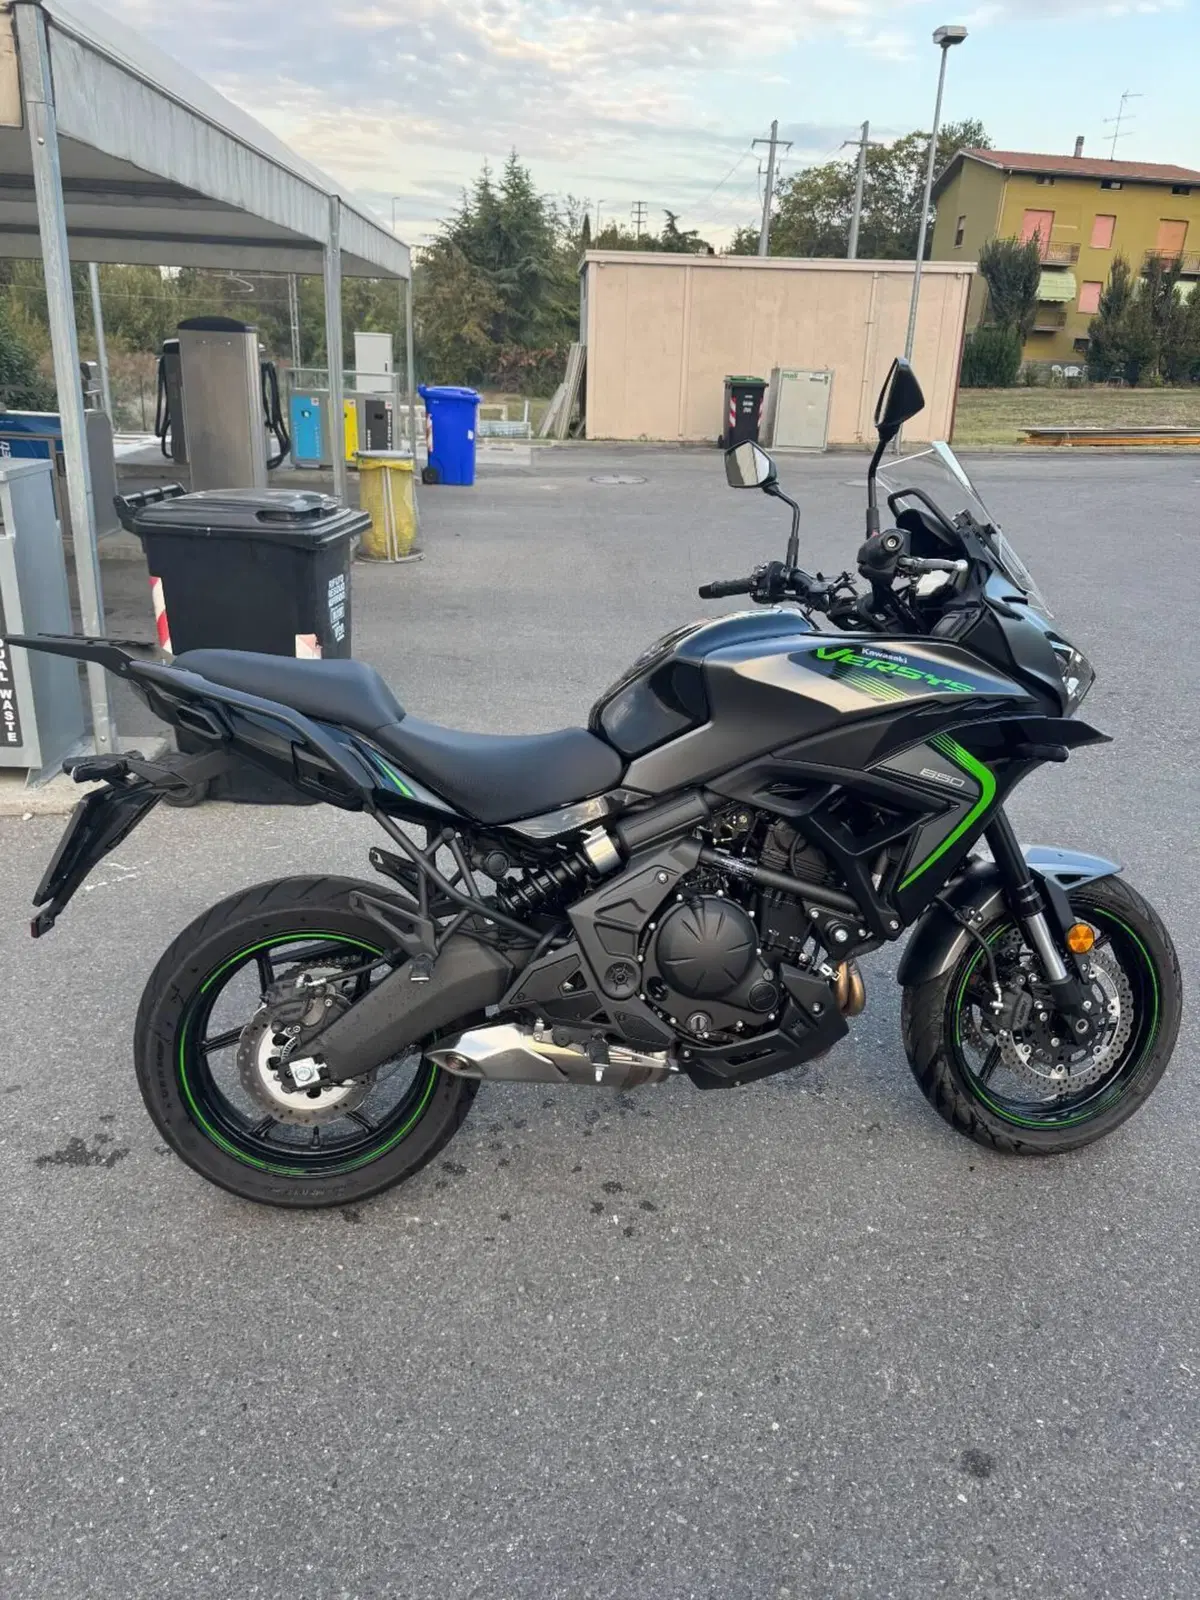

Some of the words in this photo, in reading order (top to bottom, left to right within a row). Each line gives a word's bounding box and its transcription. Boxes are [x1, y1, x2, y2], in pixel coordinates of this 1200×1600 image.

[816, 647, 976, 692] VERSYS
[861, 648, 908, 665] Kawasaki
[0, 689, 17, 742] WASTE
[919, 767, 965, 788] 650
